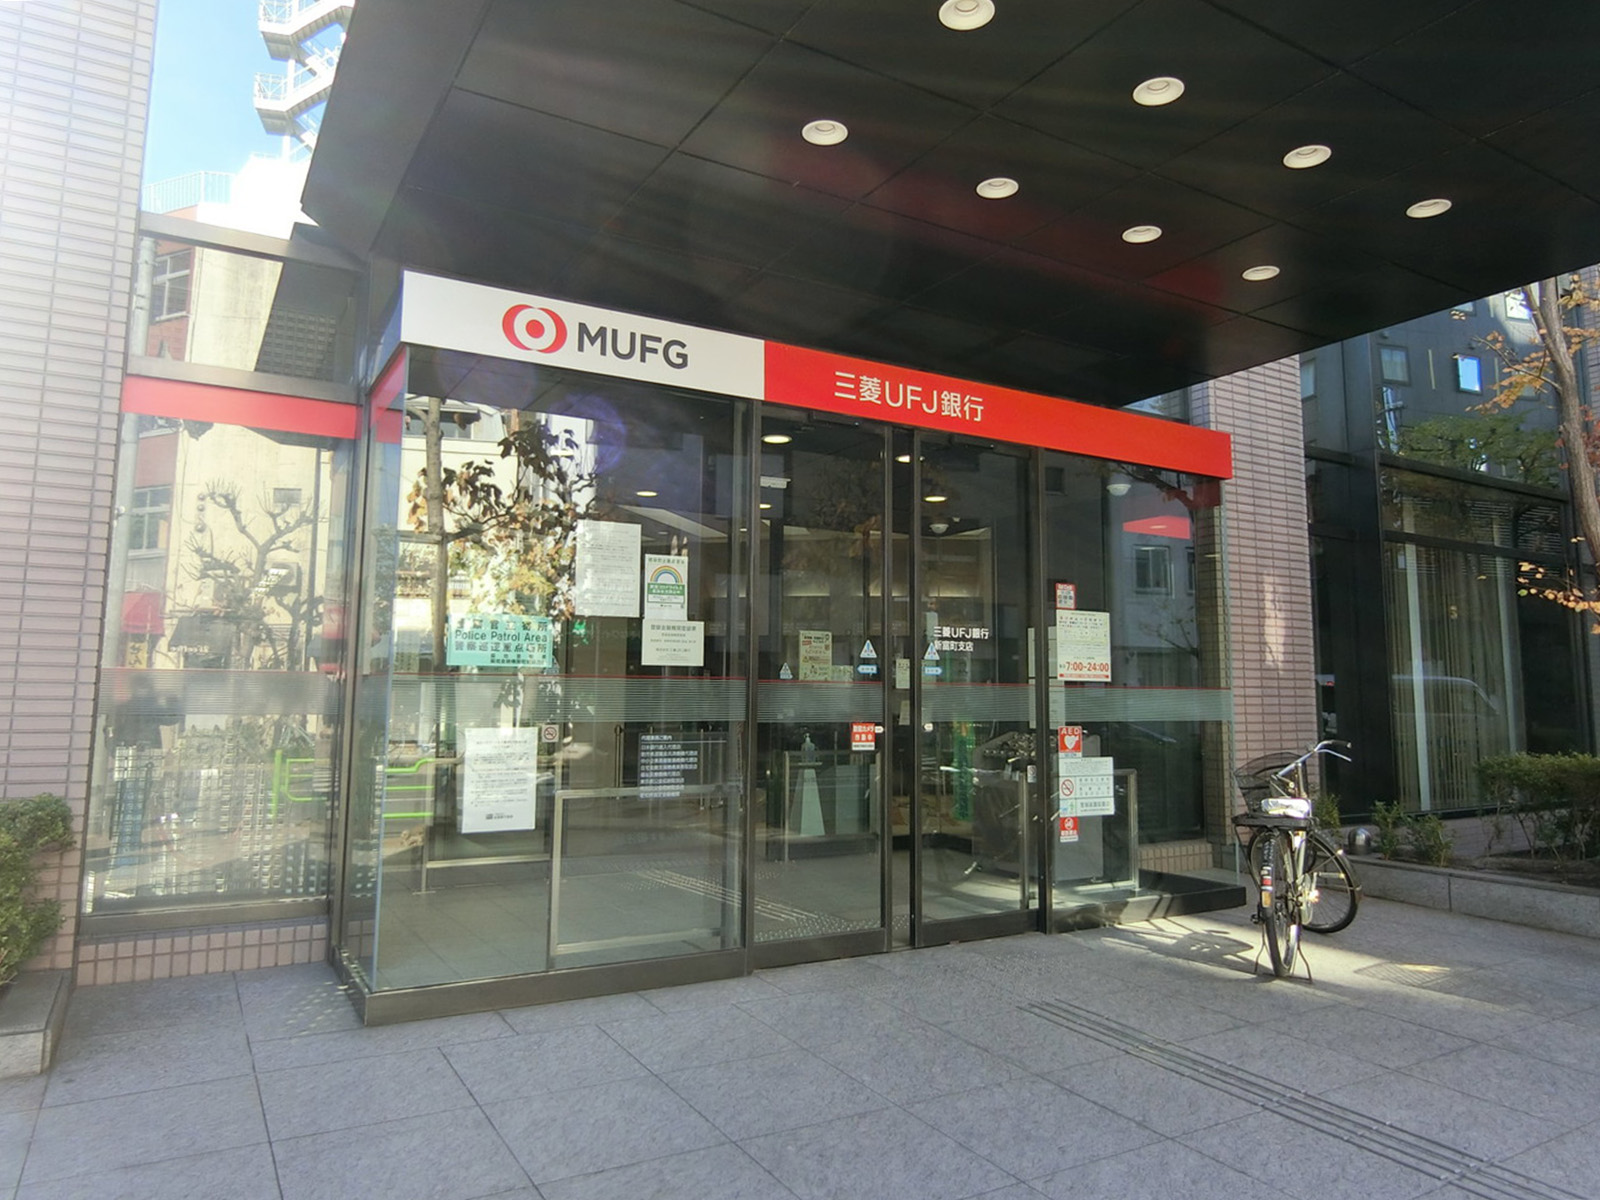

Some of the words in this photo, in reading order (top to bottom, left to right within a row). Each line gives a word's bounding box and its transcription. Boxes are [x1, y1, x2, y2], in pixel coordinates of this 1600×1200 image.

[577, 321, 689, 370] MUFG
[834, 371, 984, 422] 三菱UFJ銀行
[455, 629, 487, 640] Police
[491, 631, 520, 641] Patrol
[524, 632, 548, 642] Area
[933, 626, 990, 640] 三菱UFJ銀行
[1061, 727, 1080, 735] AED
